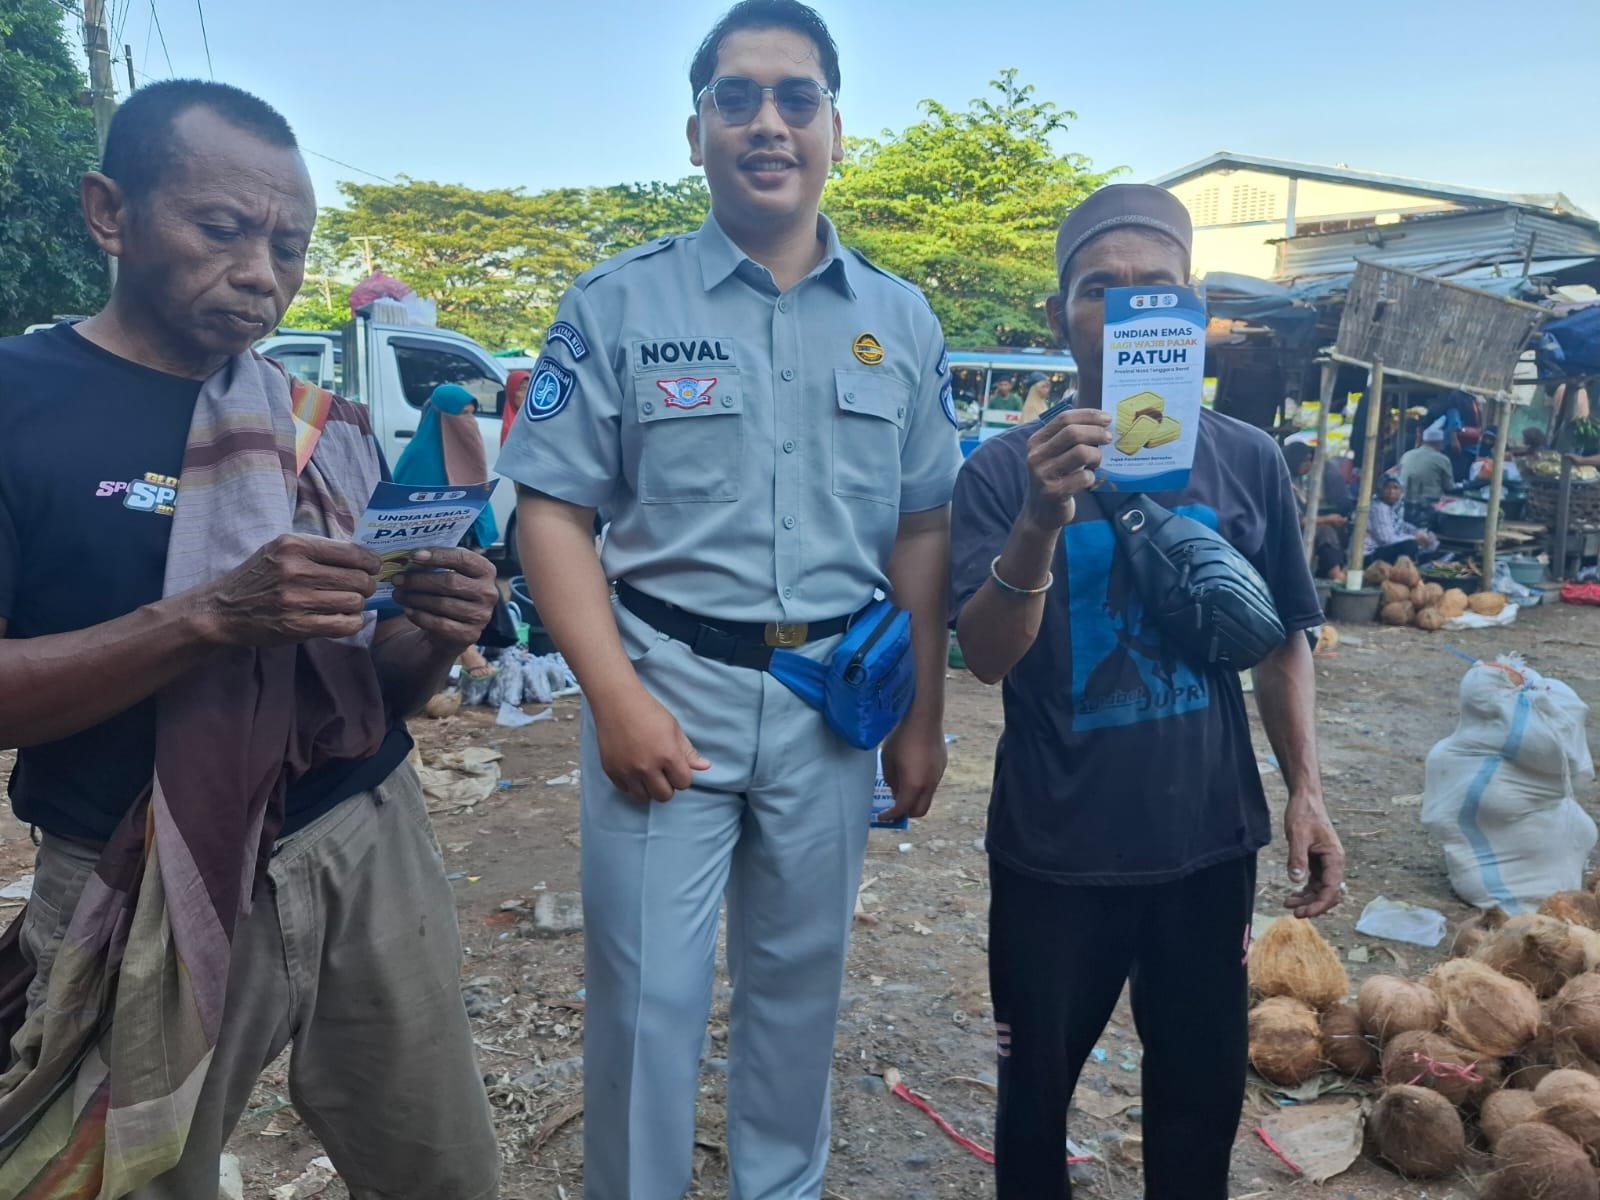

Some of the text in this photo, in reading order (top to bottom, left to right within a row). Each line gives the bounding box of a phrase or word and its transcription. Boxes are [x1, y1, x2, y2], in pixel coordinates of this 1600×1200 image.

[1113, 327, 1193, 339] UNDIAN EMAS
[640, 340, 729, 365] NOVAL
[1110, 338, 1198, 350] BAGI WAJIB PAJAK
[1117, 348, 1187, 366] PATUH
[127, 482, 176, 508] SP
[377, 508, 471, 521] UNDIAN EMAS
[373, 521, 457, 539] PATUH
